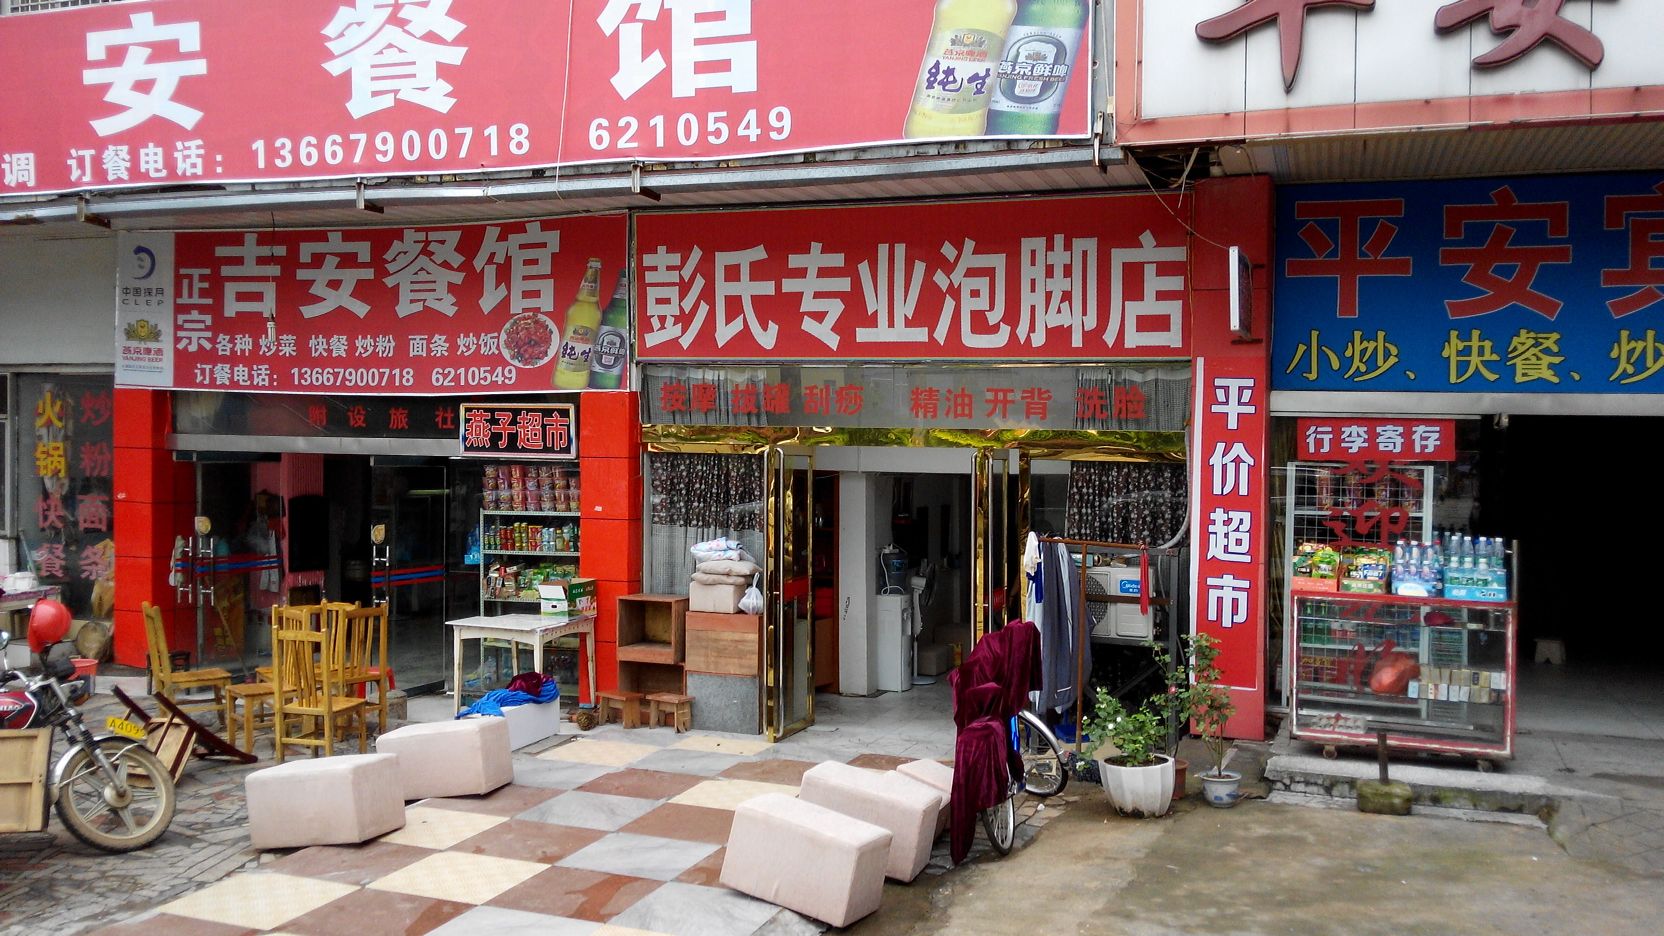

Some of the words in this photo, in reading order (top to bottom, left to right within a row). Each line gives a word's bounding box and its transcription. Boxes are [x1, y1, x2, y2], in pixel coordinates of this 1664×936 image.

[1, 153, 36, 187] 调
[67, 140, 222, 182] 订餐电话：
[251, 123, 530, 170] 13667900718
[588, 105, 793, 151] 6210549
[176, 268, 213, 353] 正宗
[214, 221, 560, 319] 吉安餐馆
[642, 229, 1188, 351] 彭氏专业泡脚店
[194, 363, 278, 387] 订餐电话：
[290, 367, 414, 387] 13667900718
[431, 366, 517, 387] 6210549
[660, 380, 717, 414] 按摩
[731, 382, 792, 415] 拔罐
[803, 383, 864, 416] 刮痧
[1075, 384, 1147, 420] 洗脸
[35, 390, 67, 479] 火锅
[465, 410, 569, 451] 燕子超市
[1305, 425, 1441, 454] 行李寄存
[35, 495, 67, 579] 快餐
[1206, 377, 1256, 629] 平价超市
